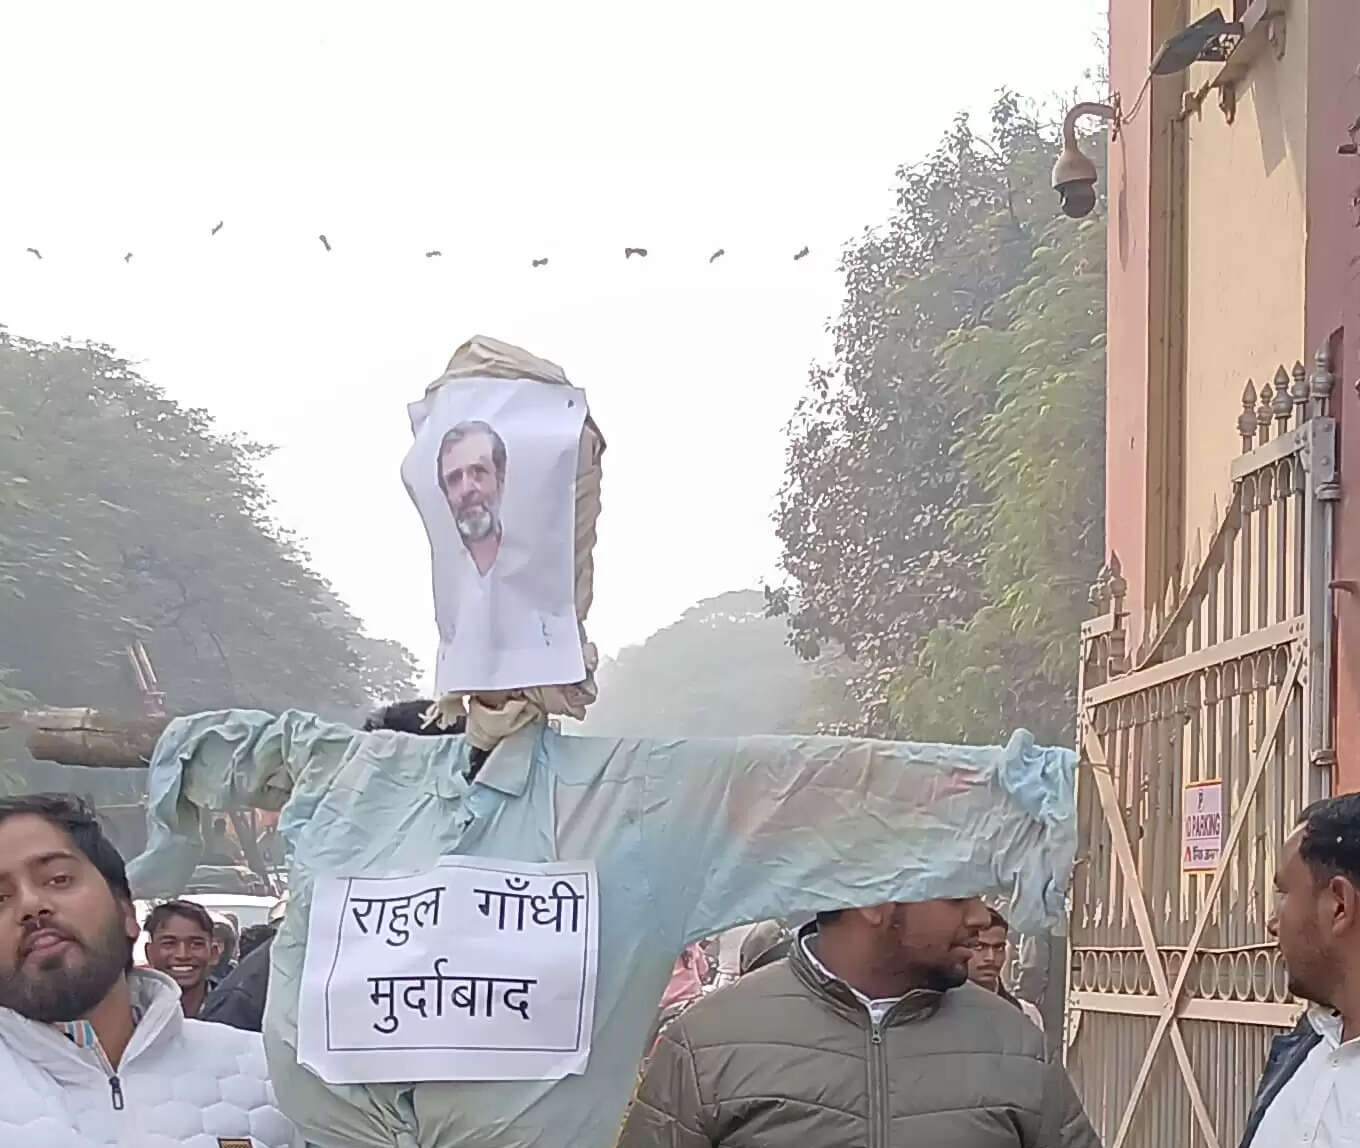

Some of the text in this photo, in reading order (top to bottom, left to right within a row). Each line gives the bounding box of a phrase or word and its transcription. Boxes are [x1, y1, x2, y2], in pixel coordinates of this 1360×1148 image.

[1192, 813, 1221, 837] PARKING
[349, 877, 585, 947] राहुल गाँधी
[367, 958, 538, 1034] मुर्दाबाद
